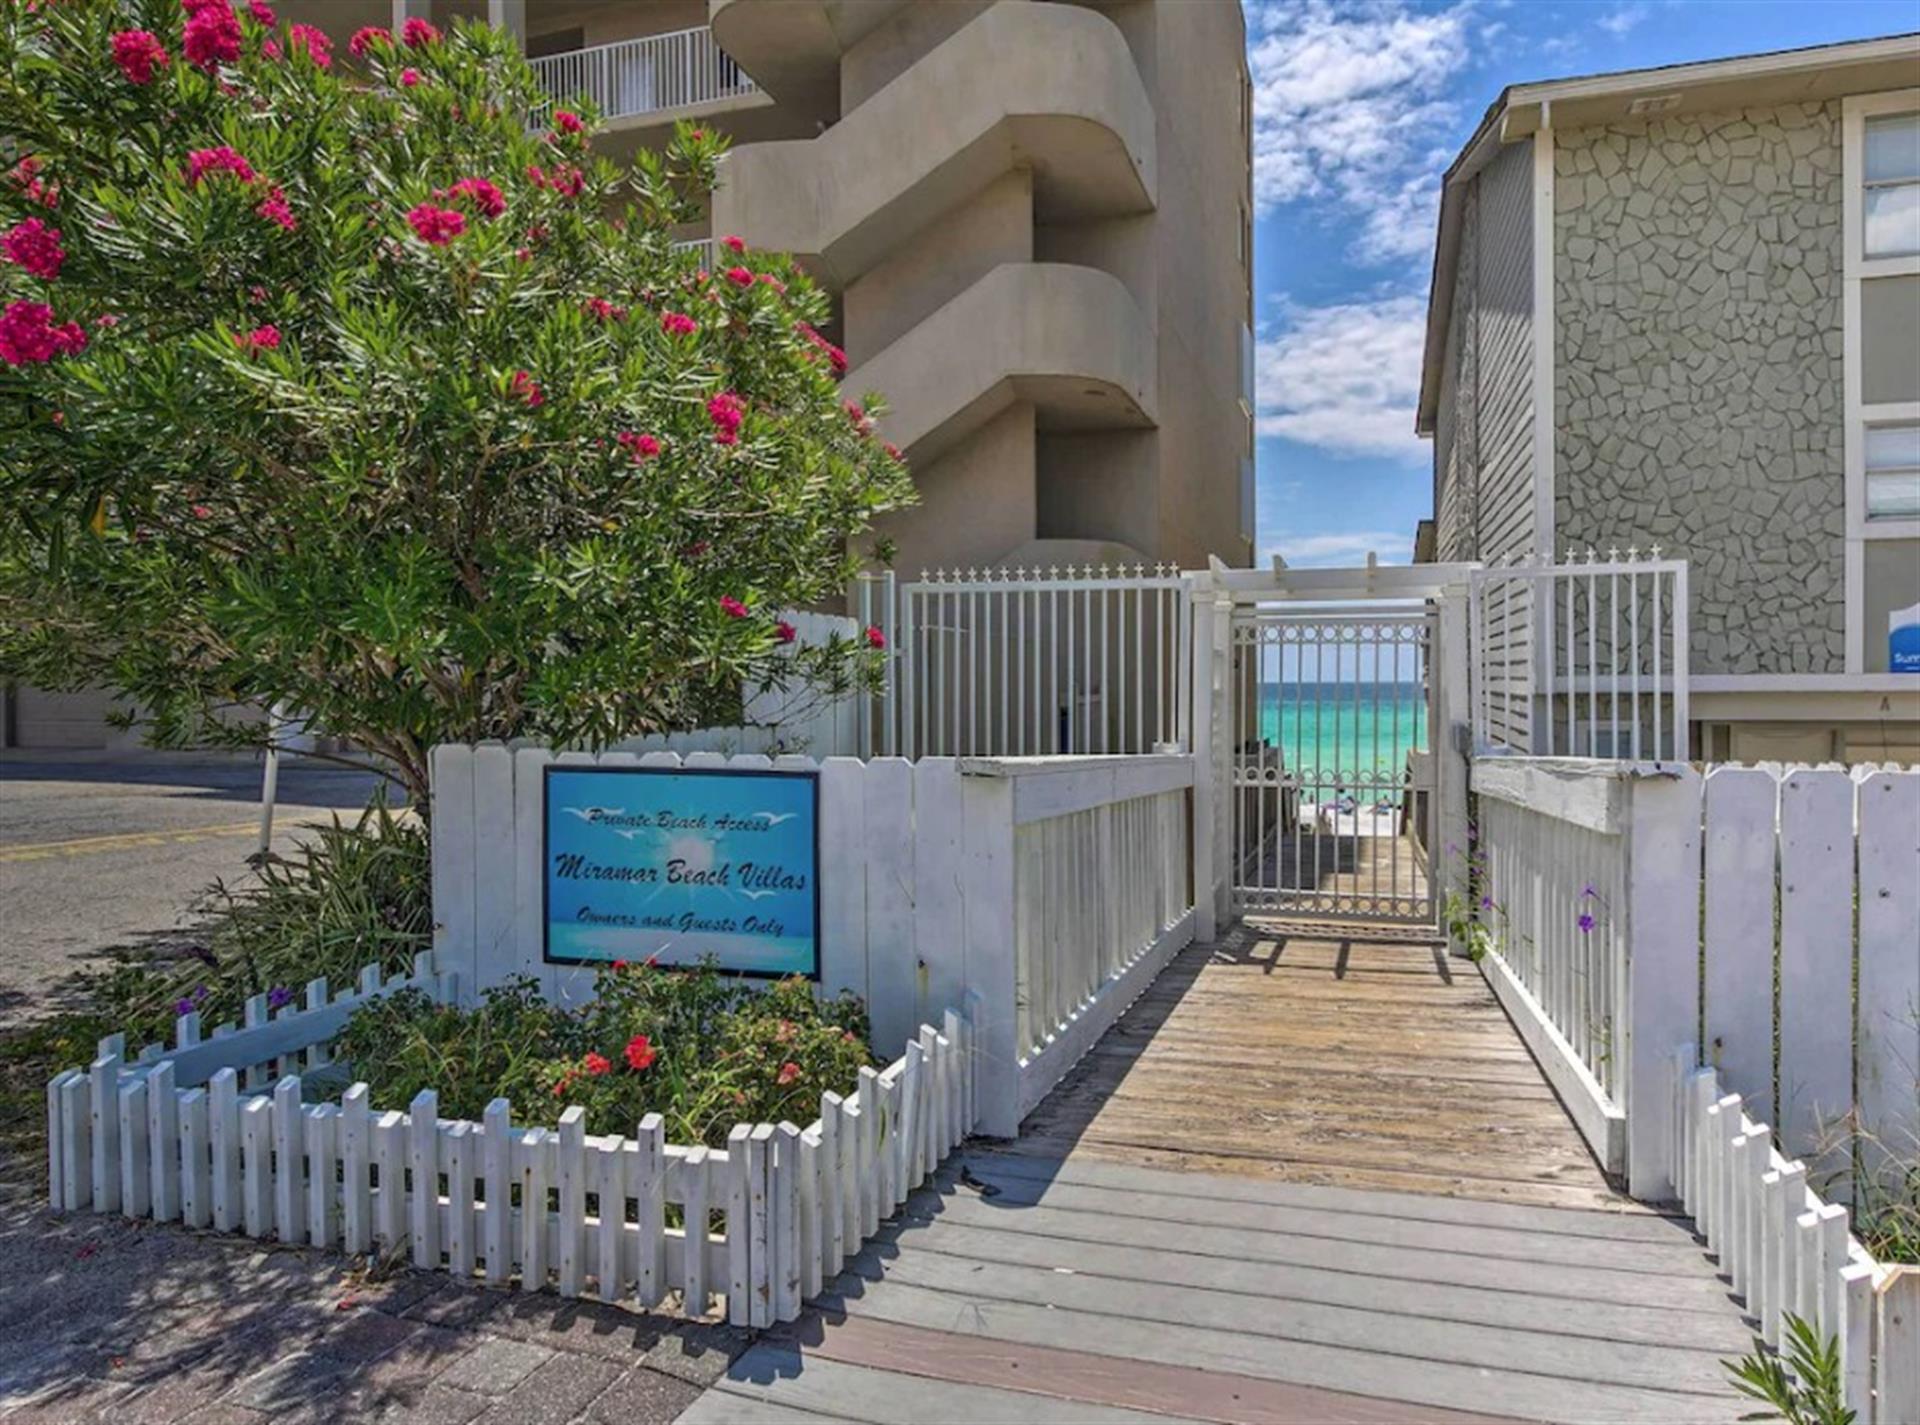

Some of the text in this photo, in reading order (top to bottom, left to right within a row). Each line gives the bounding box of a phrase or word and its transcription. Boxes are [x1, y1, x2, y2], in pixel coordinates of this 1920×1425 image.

[588, 808, 770, 831] Private Beach Access
[555, 853, 805, 890] Miramar Beach Villas
[576, 906, 783, 937] Owners and Guests Only
